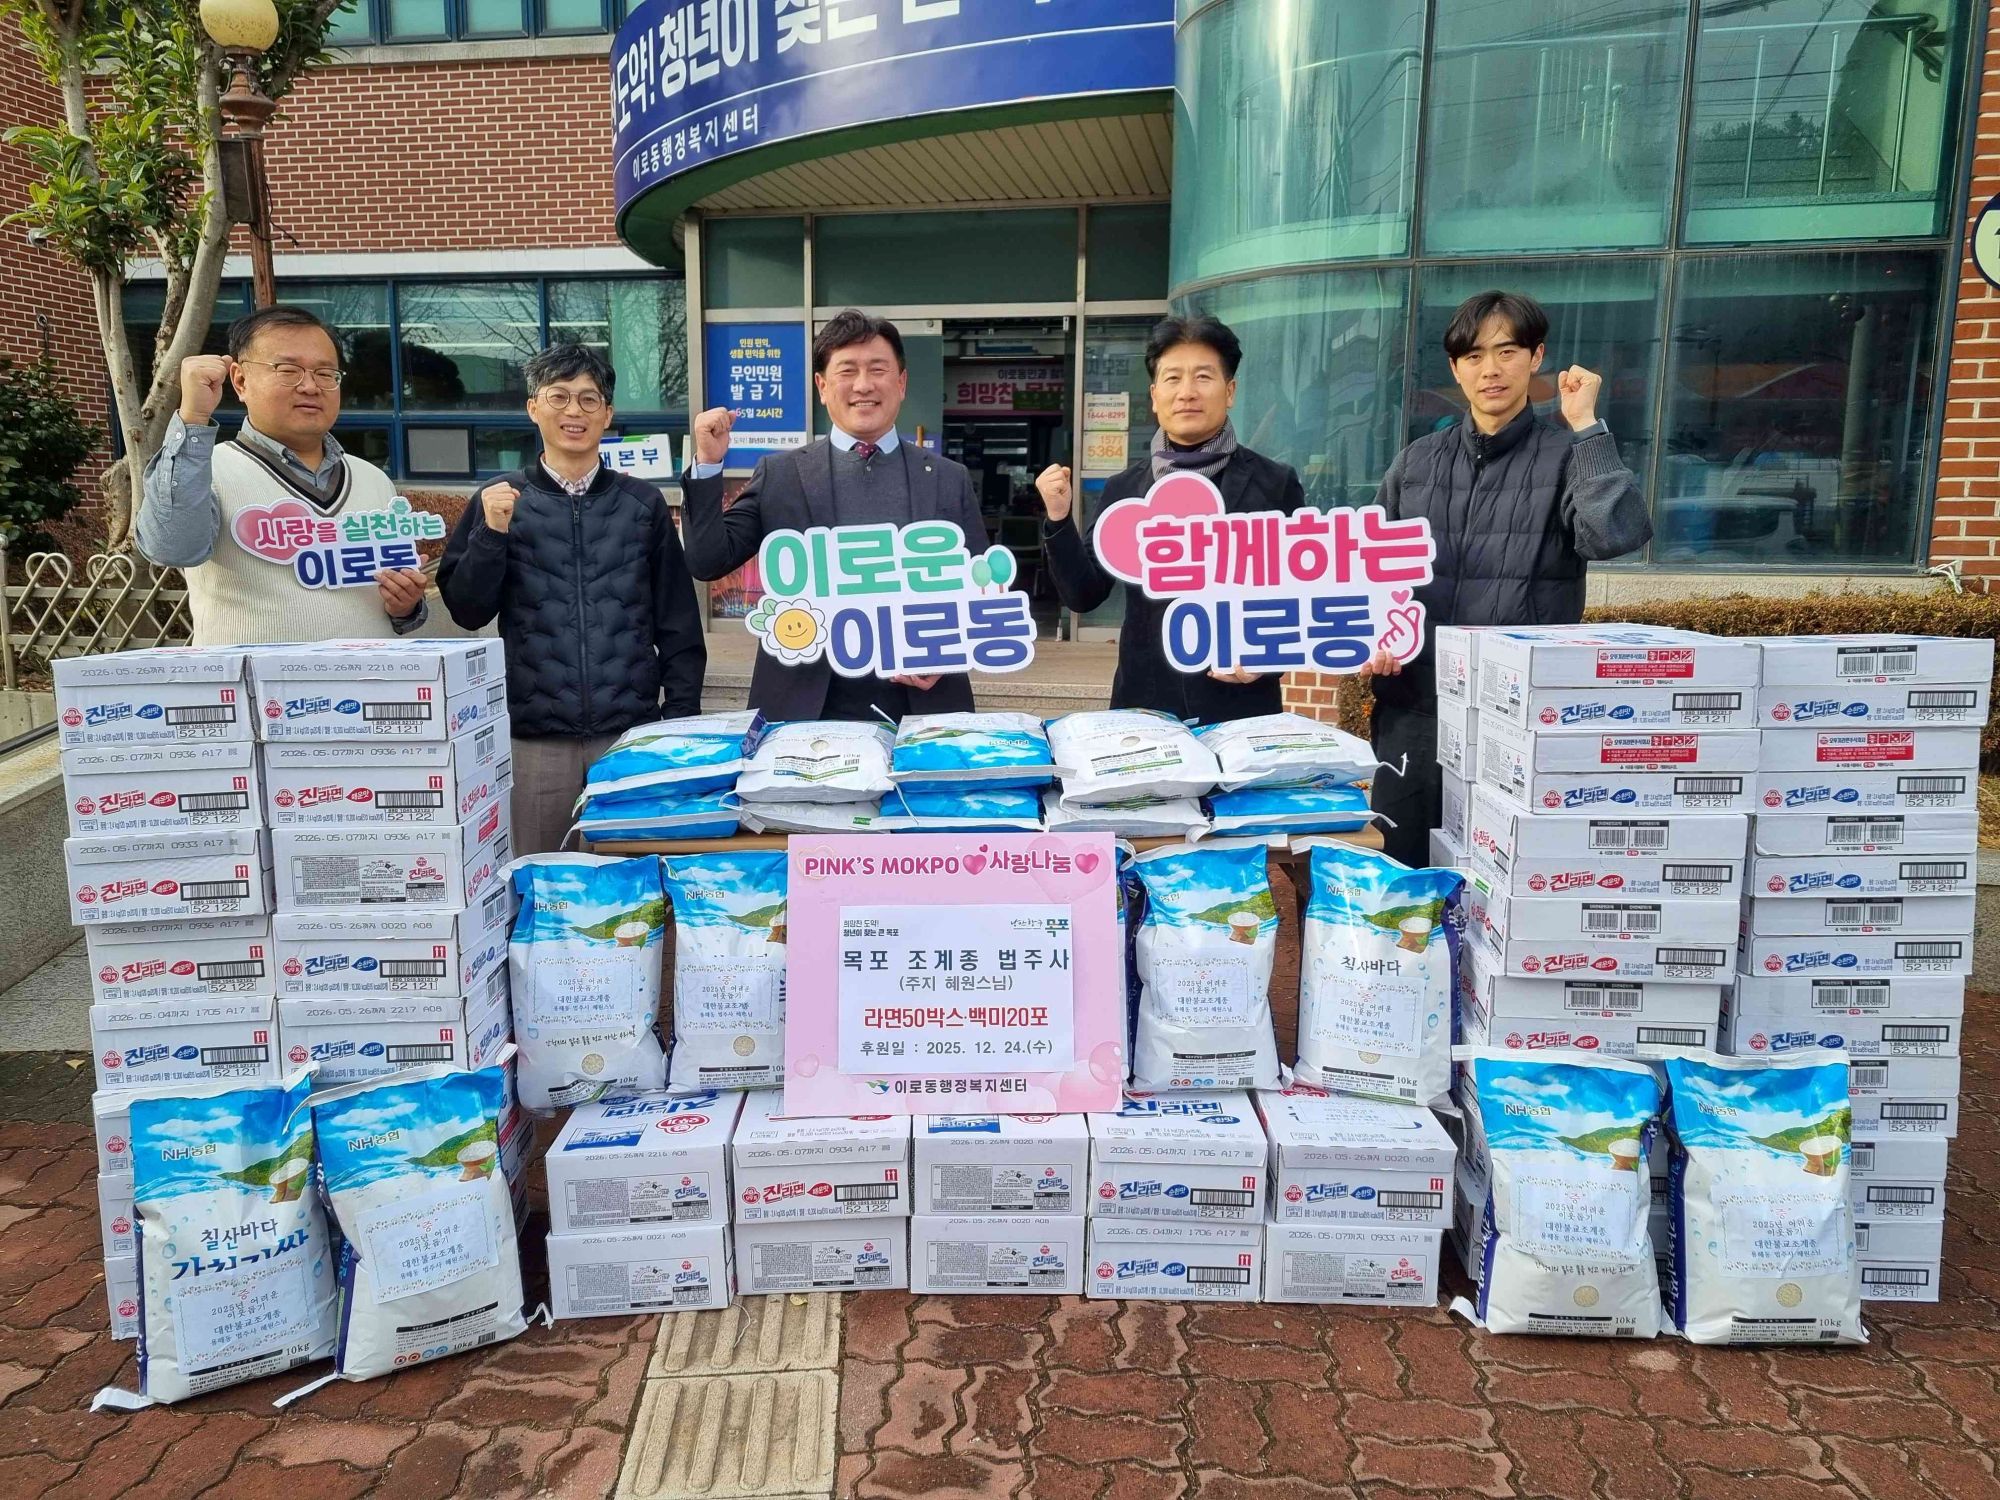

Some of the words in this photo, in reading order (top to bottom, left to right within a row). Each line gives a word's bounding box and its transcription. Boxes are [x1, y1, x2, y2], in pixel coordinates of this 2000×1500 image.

[660, 0, 759, 98] 청년이
[633, 104, 758, 183] 이로동행정복지센터
[730, 366, 782, 382] 무인민원
[732, 408, 754, 418] 65일
[756, 408, 783, 418] 24시간
[1088, 411, 1125, 419] 1644-8295
[1101, 435, 1123, 444] 1577
[1088, 446, 1123, 457] 5364
[258, 518, 337, 547] 사랑을
[342, 513, 442, 542] 실천하는
[765, 522, 965, 598] 이로운
[1143, 513, 1429, 592] 함께하는
[297, 543, 417, 585] 이로동
[830, 596, 1029, 671] 이로동
[1169, 595, 1374, 668] 이로동
[86, 704, 133, 727] 진라면
[285, 698, 331, 720] 진라면
[1561, 704, 1606, 725] 진라면
[1794, 701, 1841, 722] 진라면
[1917, 713, 1935, 721] 52
[1939, 713, 1963, 721] 121
[376, 725, 392, 734] 52
[397, 725, 419, 734] 121
[1684, 715, 1701, 724] 52
[1704, 715, 1727, 724] 121
[203, 729, 223, 737] 121
[99, 792, 146, 814] 진라면
[298, 786, 343, 807] 진라면
[1563, 787, 1609, 809] 진라면
[1786, 787, 1831, 808] 진라면
[804, 855, 875, 876] PINK'S
[881, 856, 960, 875] MOKPO
[989, 850, 1072, 874] 사랑나눔
[101, 880, 148, 903] 진라면
[1550, 873, 1595, 892] 진라면
[1673, 886, 1691, 894] 52
[1697, 886, 1718, 894] 122
[1789, 872, 1834, 893] 진라면
[193, 904, 211, 913] 52
[216, 904, 238, 912] 122
[886, 929, 899, 937] 목포
[1045, 918, 1069, 937] 목포
[305, 955, 349, 977] 진라면
[843, 950, 889, 971] 목포
[908, 950, 979, 971] 조계종
[999, 949, 1069, 971] 법주사
[1544, 954, 1589, 973] 진라면
[1786, 952, 1830, 973] 진라면
[1906, 964, 1922, 972] 52
[1927, 963, 1948, 971] 121
[122, 961, 166, 983] 진라면
[392, 982, 408, 990] 52
[413, 982, 434, 990] 121
[899, 975, 936, 992] (주지
[945, 975, 1013, 992] 혜원스님)
[860, 1041, 906, 1056] 후원일
[926, 1041, 965, 1054] 2025.
[974, 1041, 995, 1054] 12.
[1004, 1040, 1053, 1056] 24.(수)
[1526, 1033, 1572, 1050] 진라면
[1771, 1032, 1817, 1052] 진라면
[125, 1046, 169, 1068] 진라면
[311, 1042, 355, 1063] 진라면
[895, 1079, 1027, 1093] 이로동행정복지센터
[1396, 1076, 1418, 1087] 10kg
[1504, 1104, 1551, 1116] NH농협
[348, 1131, 400, 1153] NH농협
[162, 1144, 217, 1161] NH농협
[763, 1183, 805, 1204] 진라면
[1120, 1181, 1162, 1200] 진라면
[1306, 1183, 1349, 1203] 진라면
[846, 1205, 862, 1213] 52
[201, 1218, 278, 1251] 칠산바다
[1117, 1260, 1159, 1280] 진라면
[1616, 1316, 1636, 1324] 10kg
[1820, 1318, 1842, 1328] 10kg
[286, 1342, 310, 1356] 10kg
